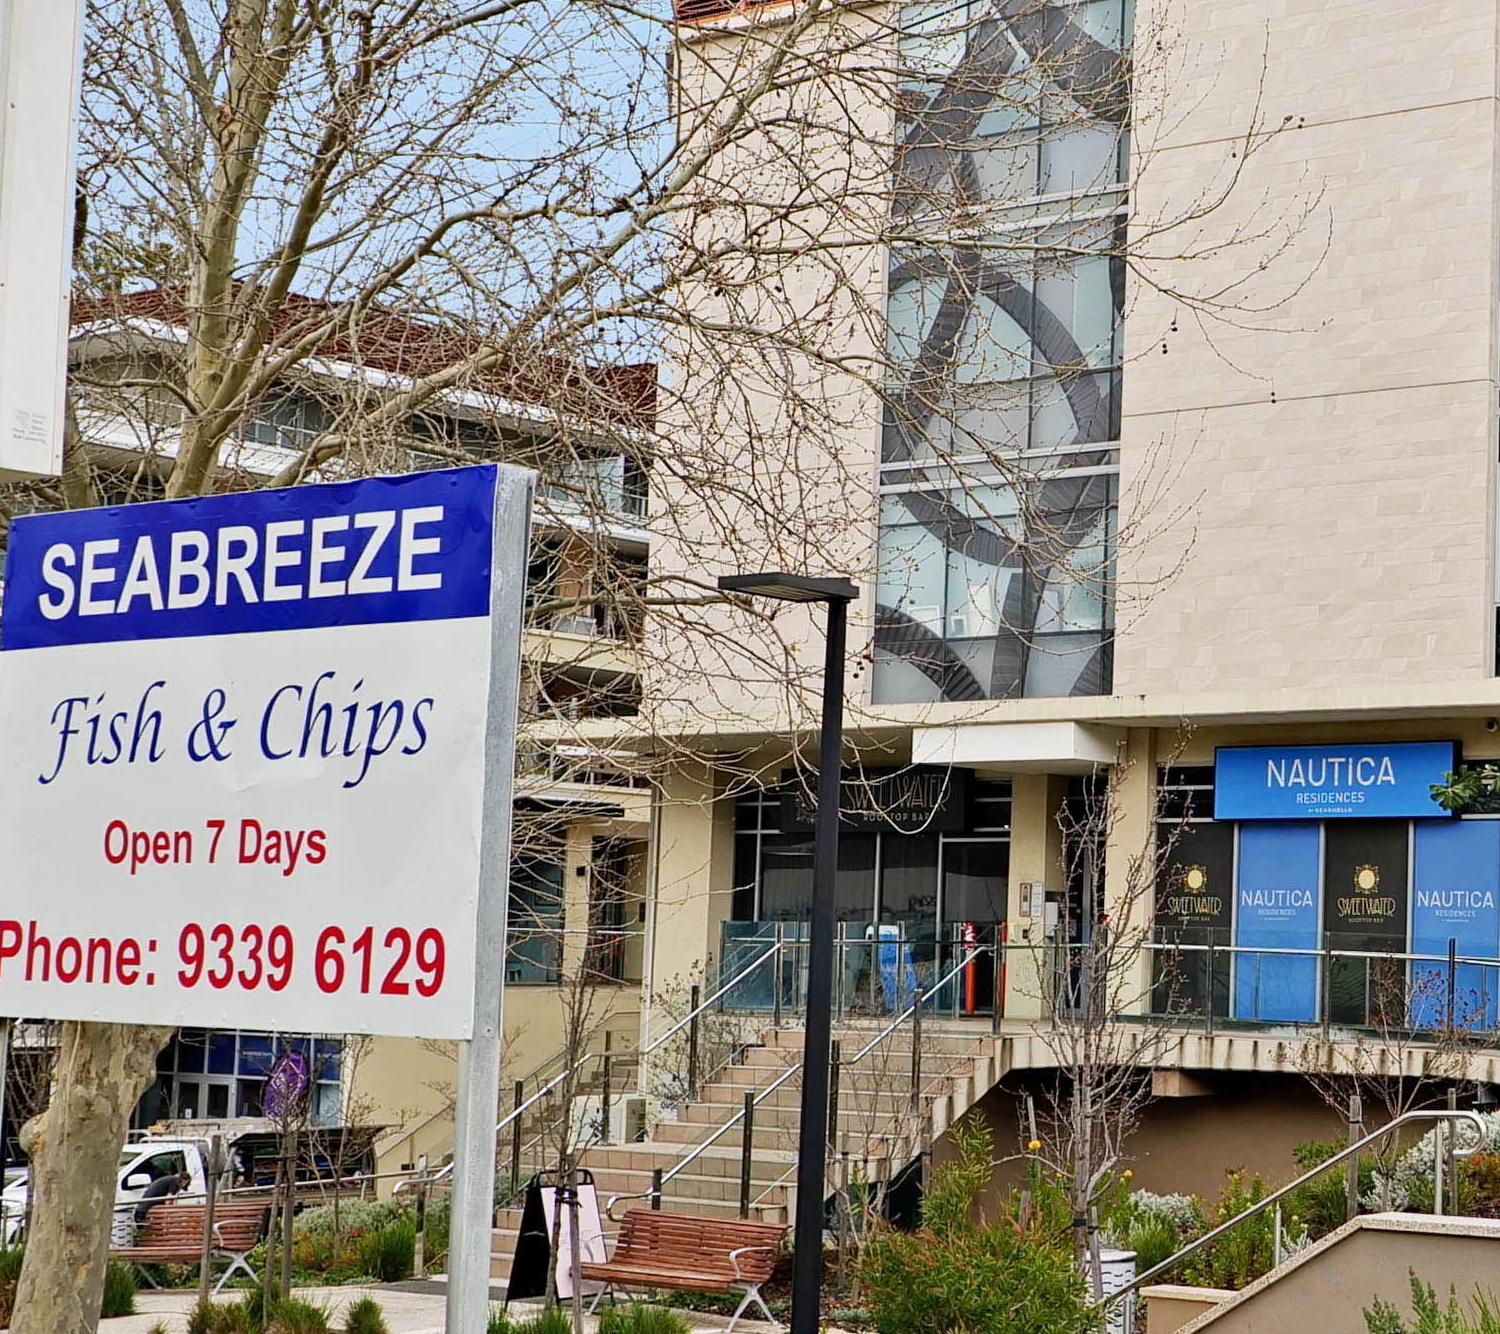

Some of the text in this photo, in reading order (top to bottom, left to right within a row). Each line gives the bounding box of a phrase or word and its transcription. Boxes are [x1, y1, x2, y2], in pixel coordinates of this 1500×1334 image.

[38, 505, 444, 621] SEABREEZE
[38, 670, 434, 789] Fish & Chips
[1266, 756, 1396, 788] NAUTICA
[1296, 791, 1365, 804] RESIDENCES
[103, 818, 327, 876] Open 7 Days
[1241, 890, 1314, 907] NAUTICA
[1417, 890, 1494, 908] NAUTICA
[178, 922, 295, 992] 9339
[314, 925, 447, 997] 6129
